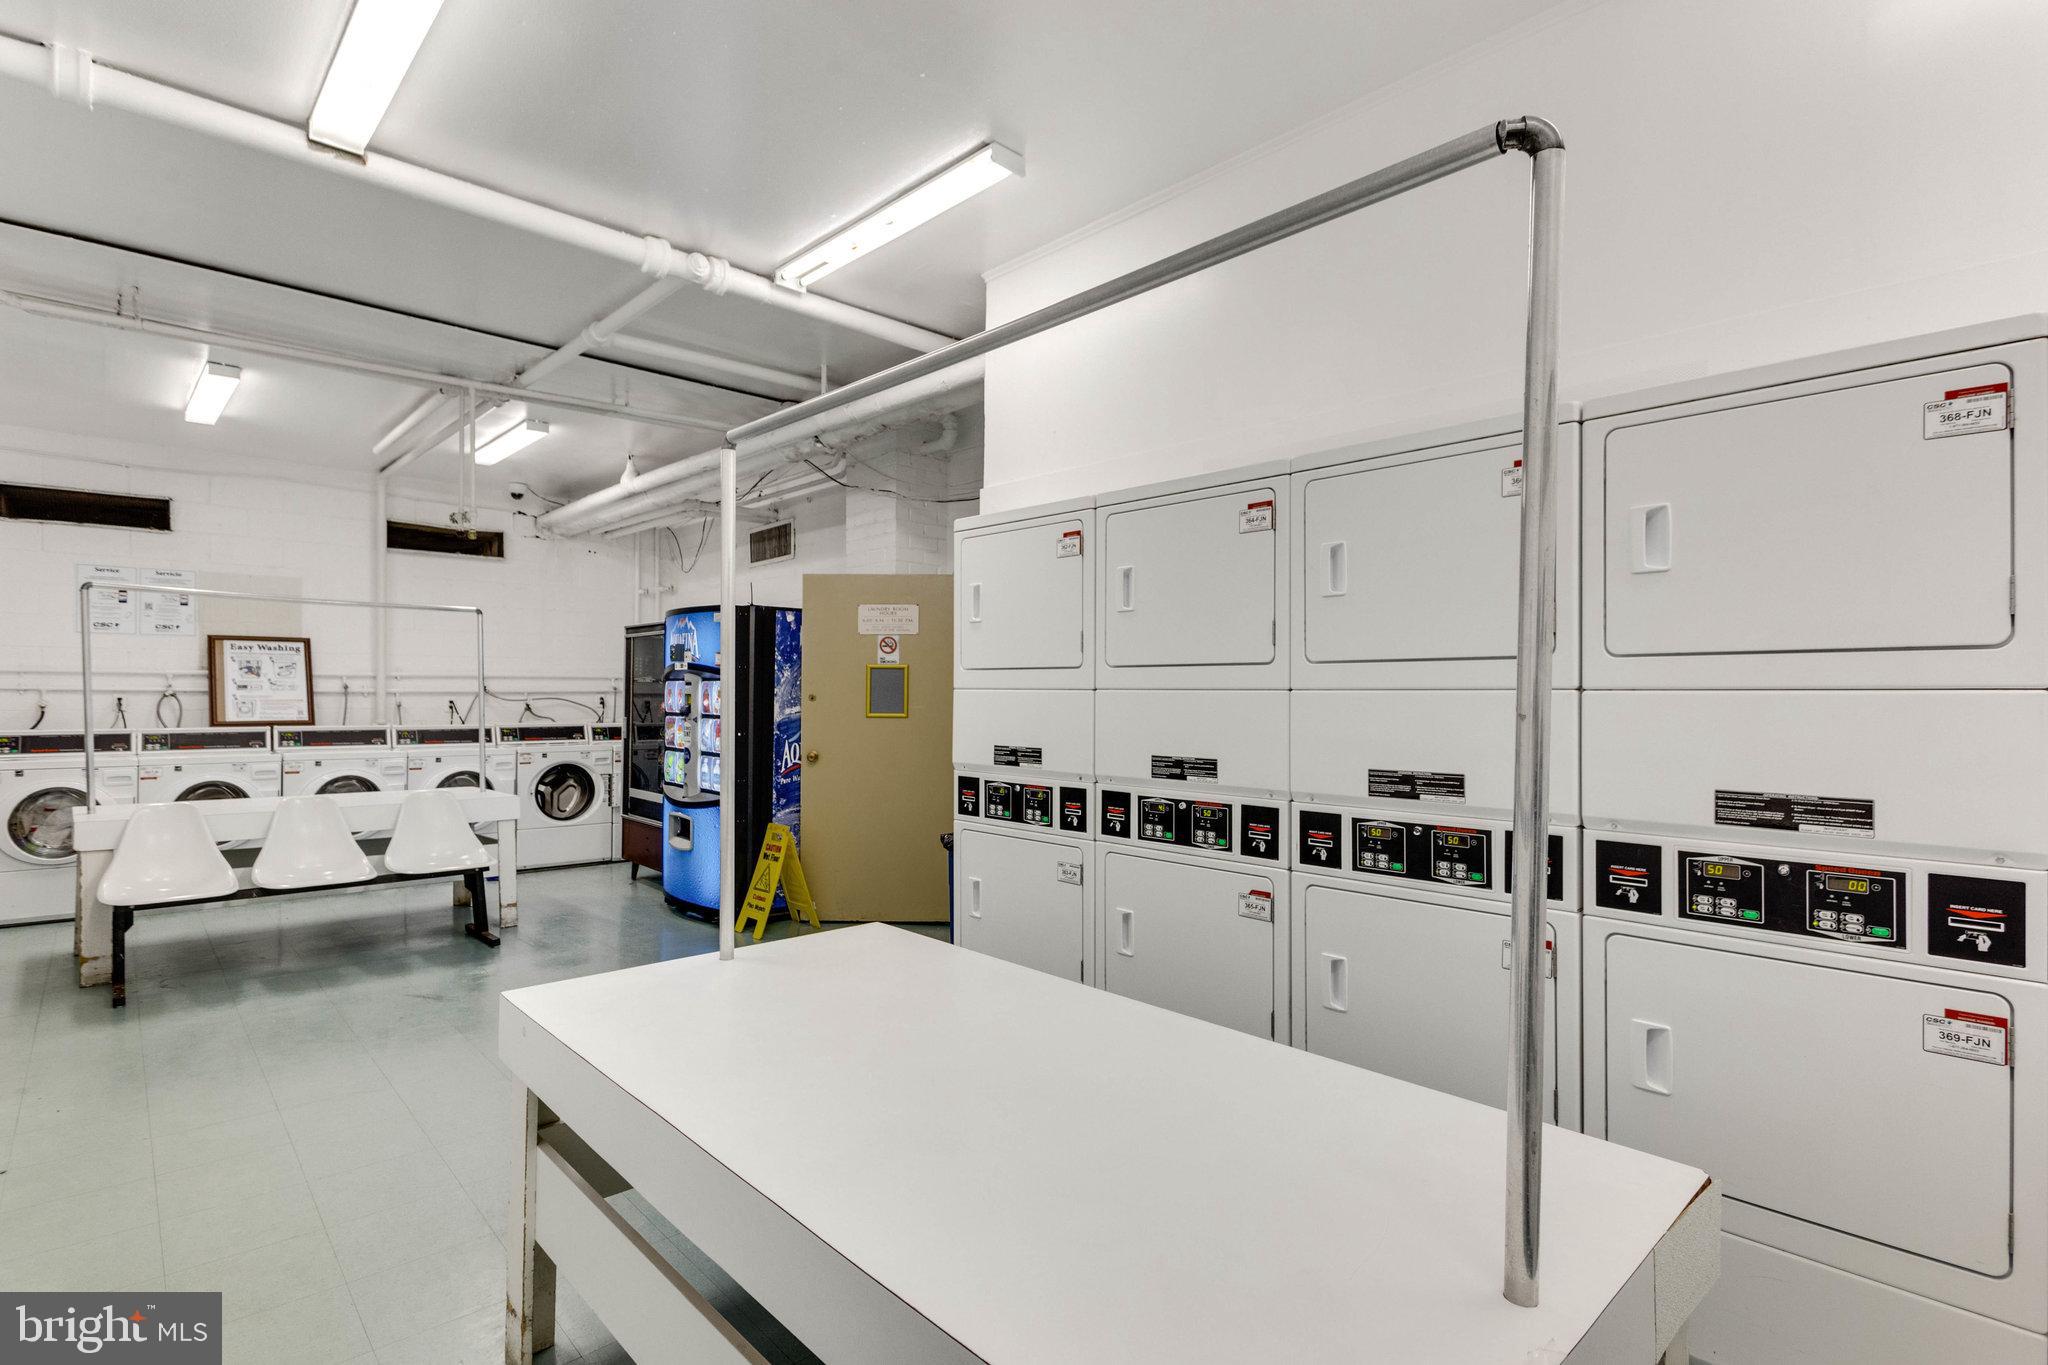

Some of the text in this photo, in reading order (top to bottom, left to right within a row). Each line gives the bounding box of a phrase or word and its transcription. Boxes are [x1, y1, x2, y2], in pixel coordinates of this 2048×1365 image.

[1926, 402, 1947, 410] CSC
[1939, 408, 1992, 423] 368-FJN
[230, 643, 302, 654] Easy Washing
[780, 739, 801, 773] AQ
[1707, 864, 1723, 875] 50
[1814, 864, 1881, 877] Speed Queen
[1848, 880, 1867, 892] 00
[1925, 1016, 1946, 1025] CSC
[1938, 1030, 1991, 1048] 369-FJN
